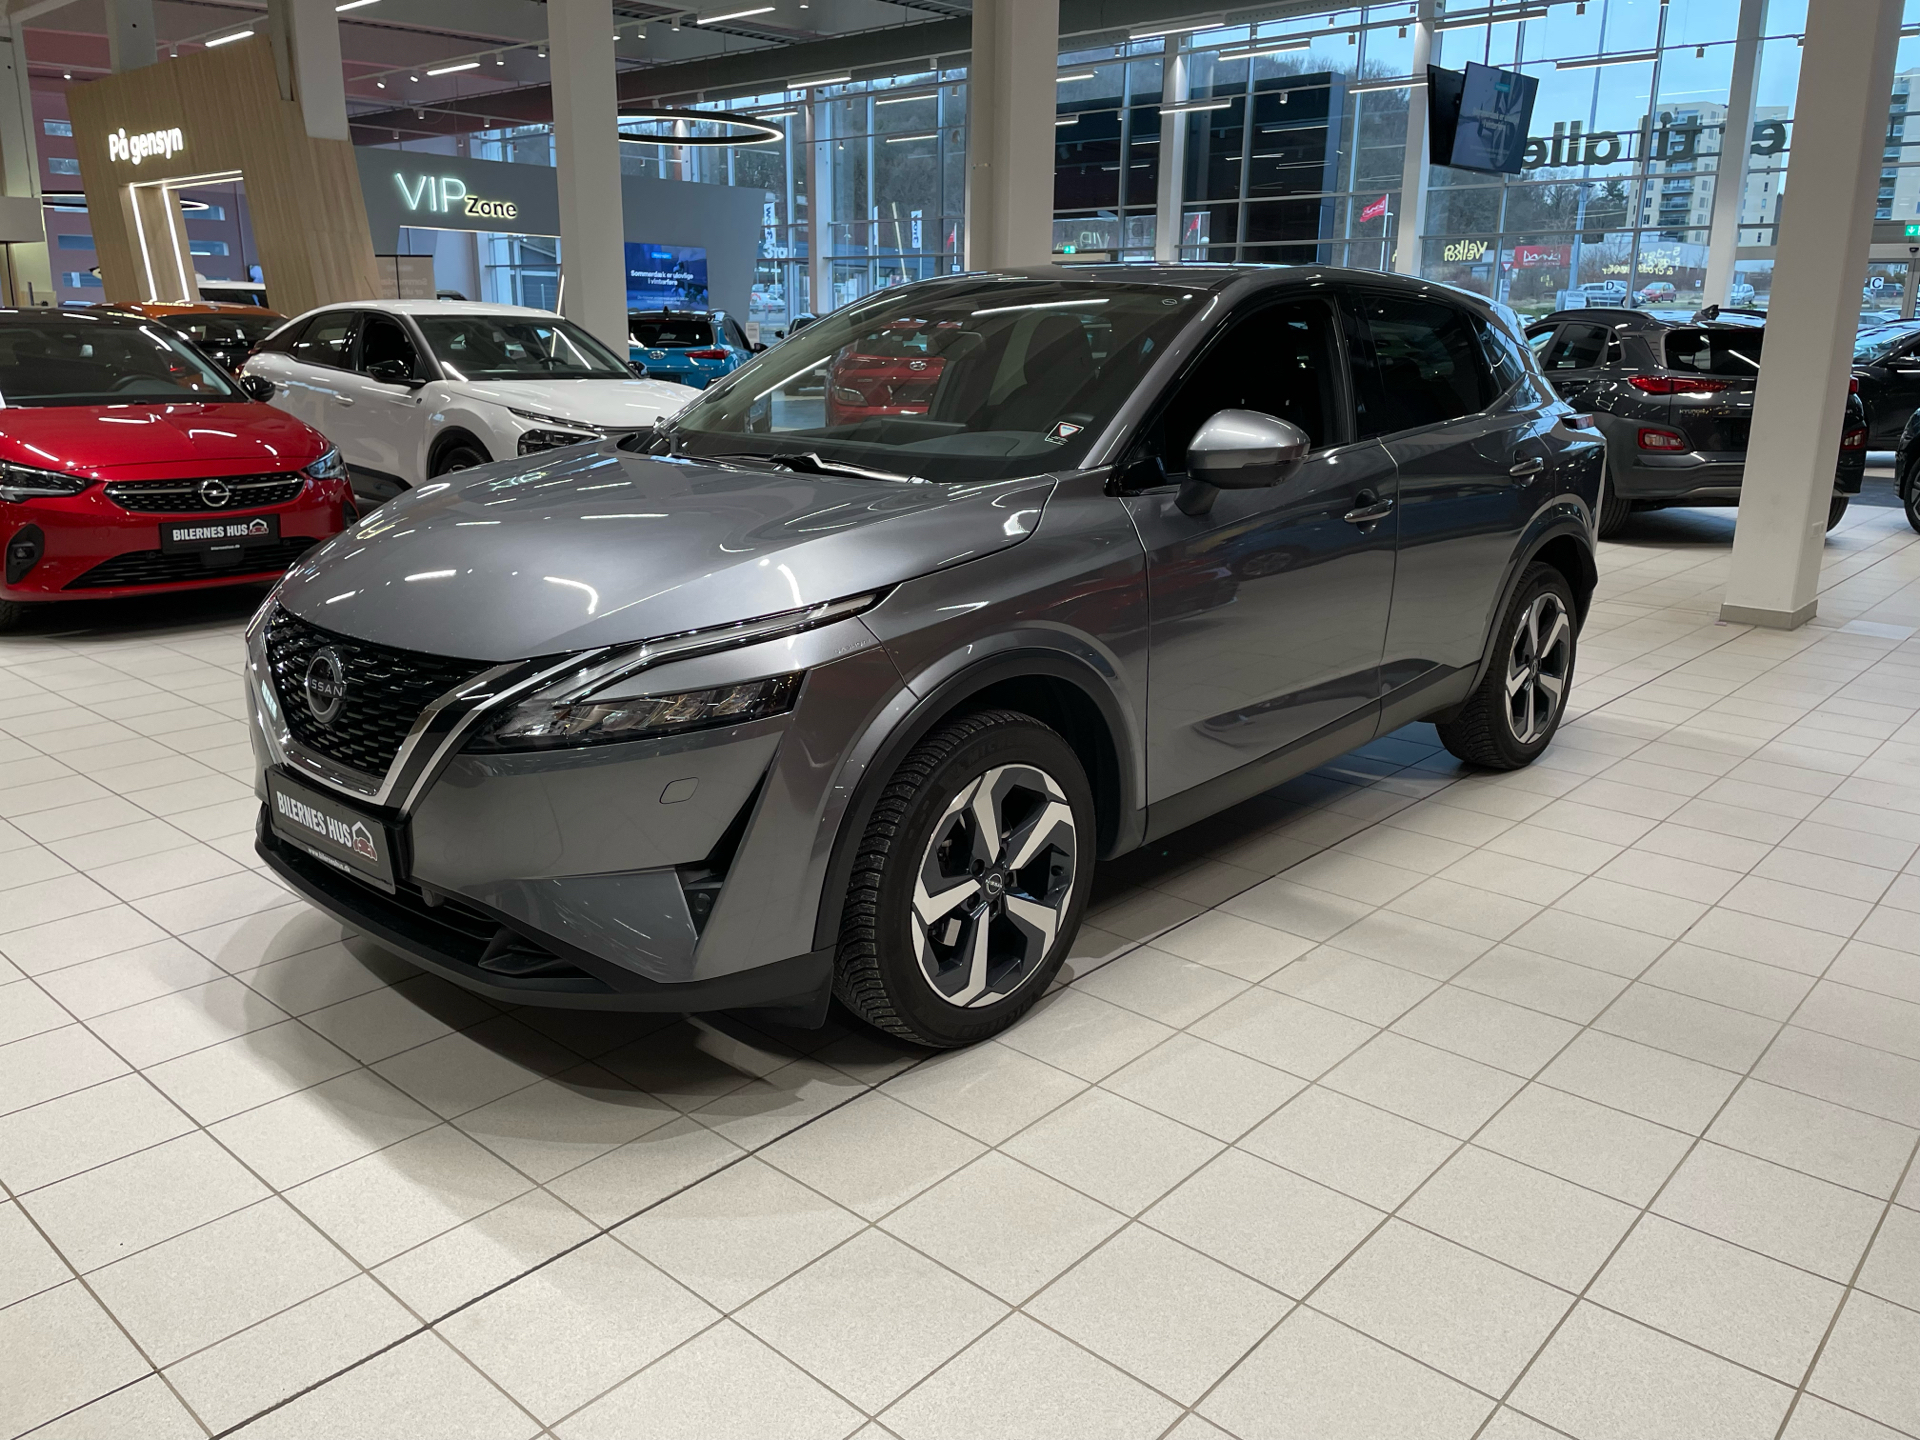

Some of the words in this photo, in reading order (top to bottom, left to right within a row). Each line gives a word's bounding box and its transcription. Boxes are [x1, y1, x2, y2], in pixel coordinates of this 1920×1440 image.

[108, 128, 130, 162] På
[130, 127, 184, 165] gensyn
[395, 172, 467, 213] VIP
[464, 195, 517, 219] Zone
[1605, 281, 1615, 290] D
[1871, 277, 1882, 288] C
[172, 527, 225, 542] BILERNES
[226, 524, 248, 537] HUS
[276, 790, 326, 836] BILERNES
[326, 815, 352, 848] HUS
